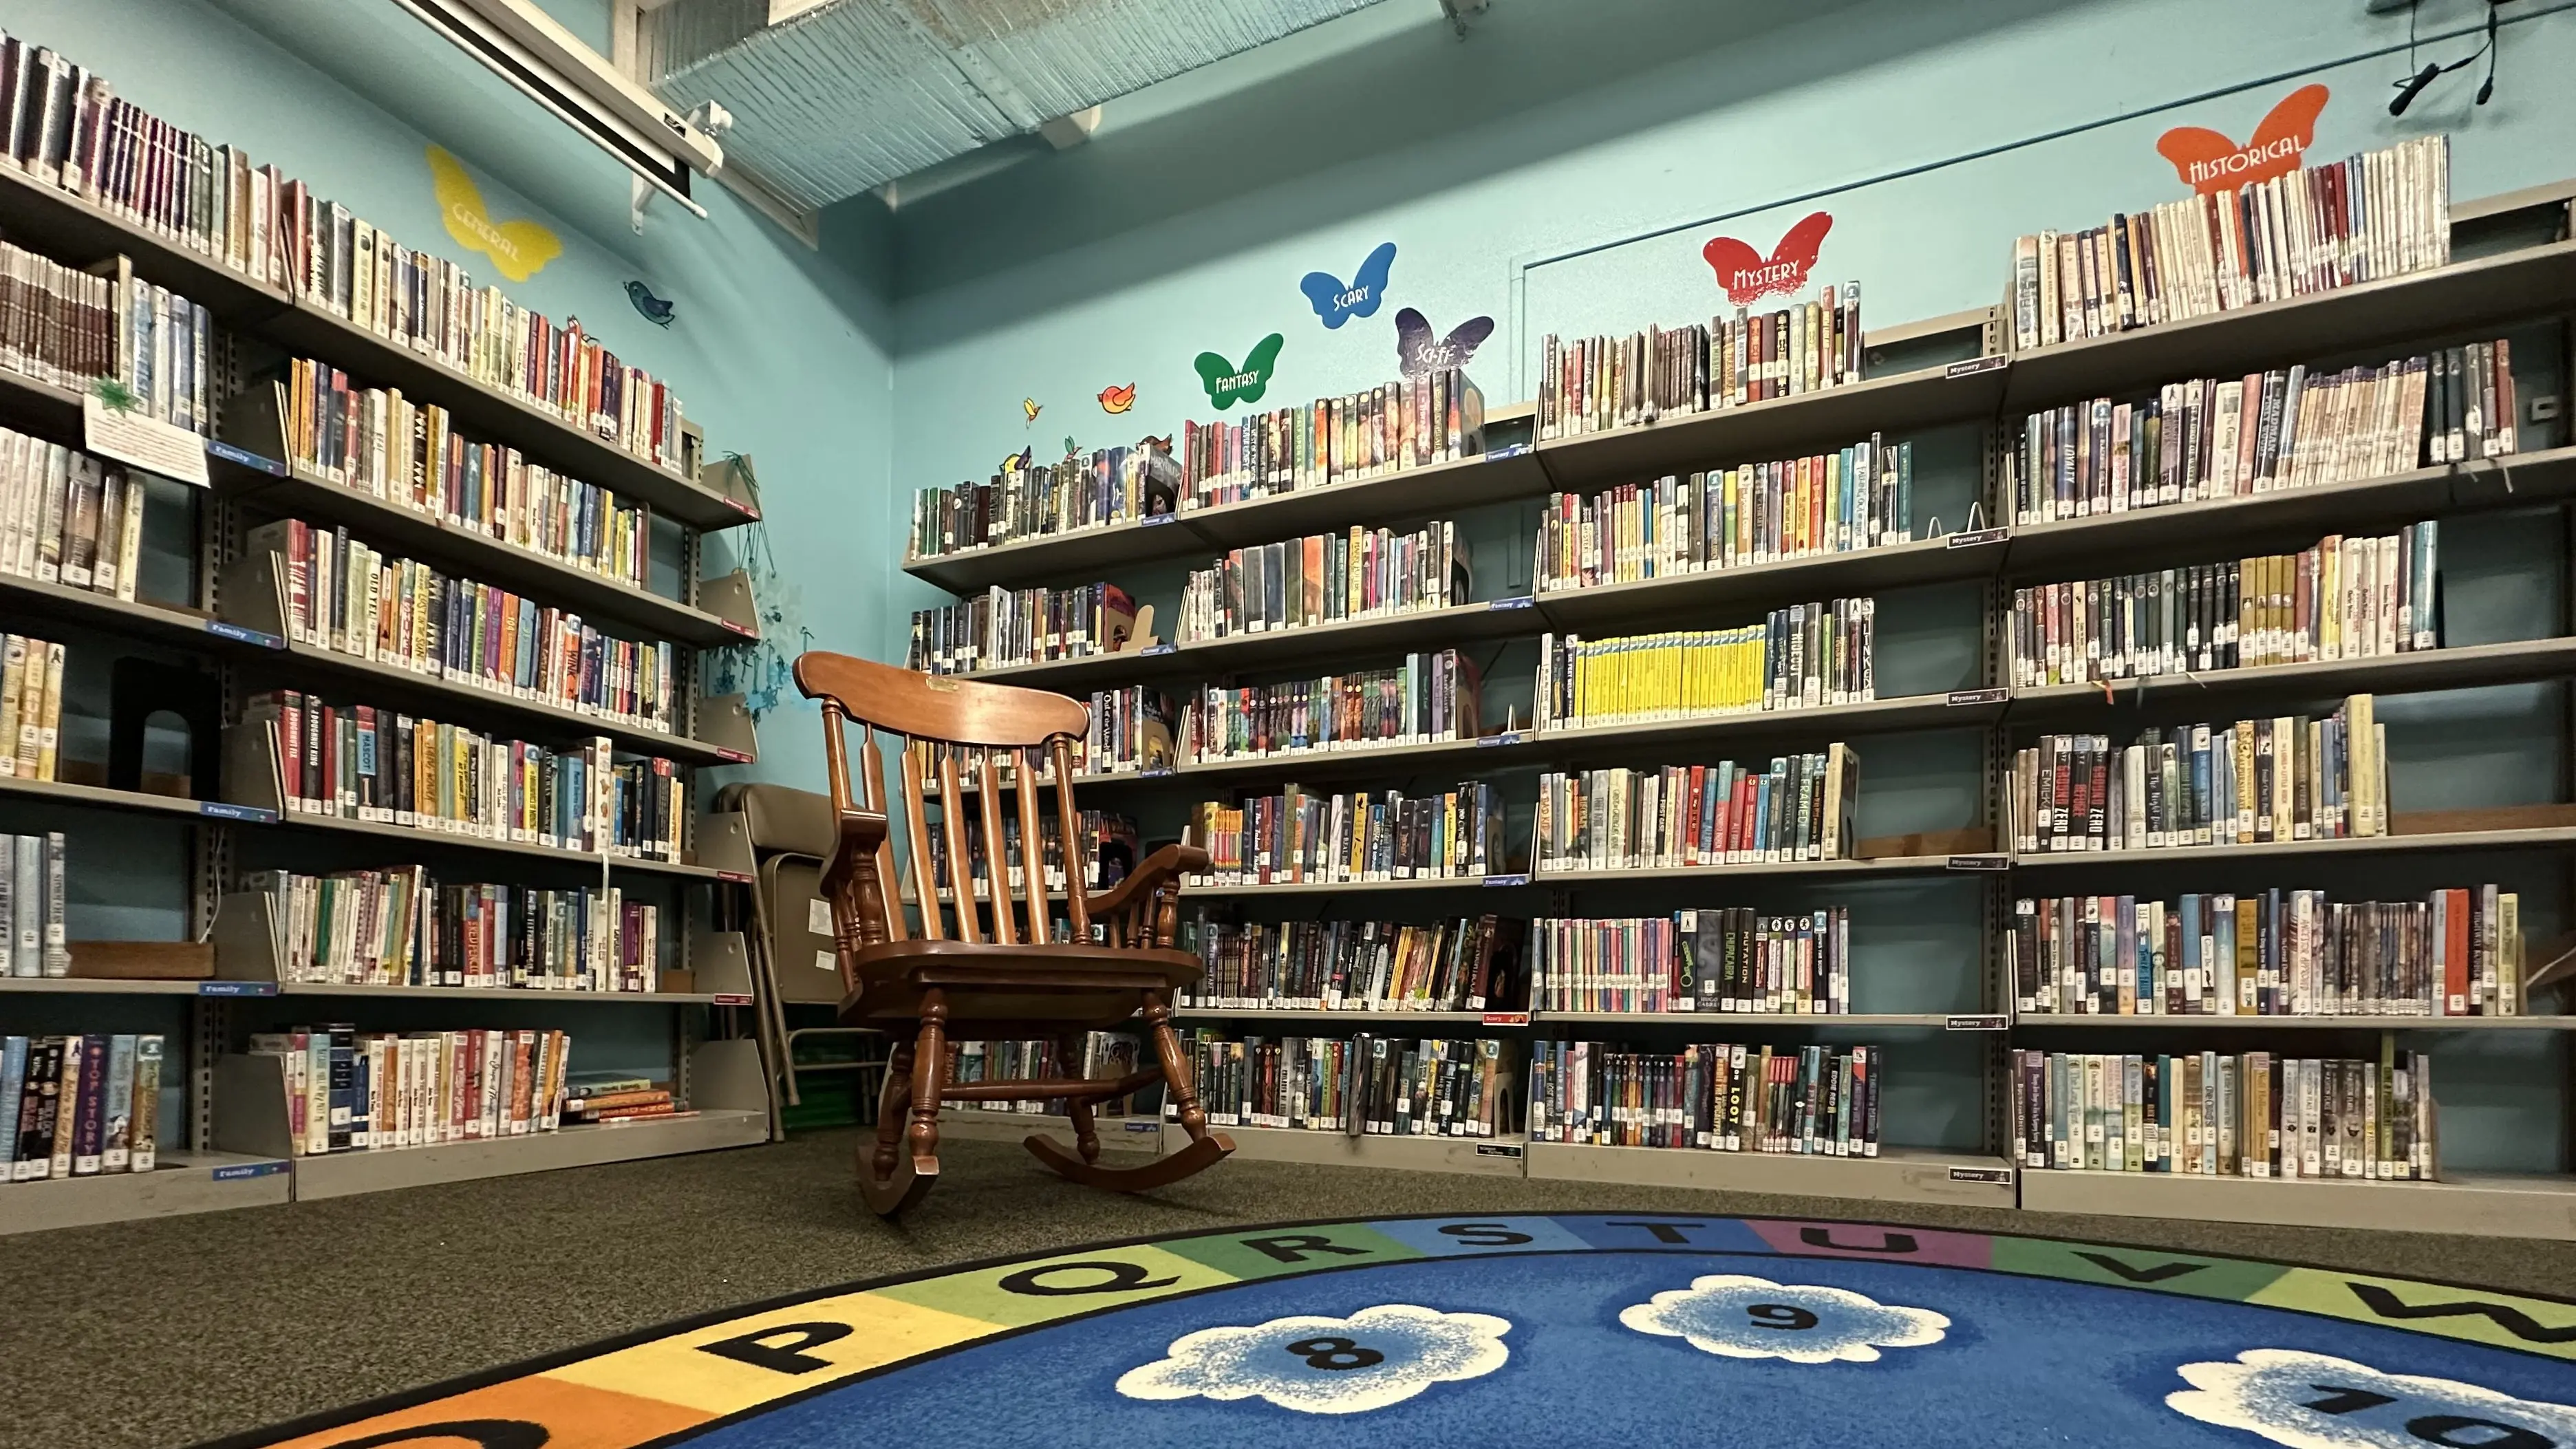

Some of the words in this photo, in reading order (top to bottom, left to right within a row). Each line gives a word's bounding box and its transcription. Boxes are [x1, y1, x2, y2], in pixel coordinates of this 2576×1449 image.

[2189, 135, 2305, 183] HISTORICAL
[451, 204, 521, 263] GENERAL
[1733, 259, 1800, 290] MYSTERY
[1333, 285, 1369, 312] SCARY
[1216, 370, 1259, 394] FANTASY
[1951, 363, 1980, 374] Mystery
[2268, 399, 2281, 452] MADMAN
[215, 446, 249, 462] Family
[2064, 444, 2074, 484] LOYALTY
[1951, 535, 1982, 544] Mystery
[213, 624, 247, 638] Family
[568, 649, 580, 677] WINK
[1791, 634, 1802, 677] HIDEOUT
[1103, 694, 1113, 709] Out
[1951, 694, 1981, 702] Mystery
[361, 734, 371, 770] MASCOT
[2056, 765, 2070, 804] GROUND
[2092, 765, 2106, 804] GROUND
[2150, 776, 2160, 788] The
[208, 806, 242, 817] Family
[2073, 784, 2086, 817] REFUGEE
[2149, 792, 2160, 814] Night
[2054, 808, 2068, 833] ZERO
[2089, 808, 2104, 833] ZERO
[2203, 938, 2213, 954] Glory
[2300, 919, 2310, 954] ANCESTOR
[1725, 932, 1735, 980] CHUPACABRA
[1730, 1086, 1740, 1124] LOOT
[219, 1168, 255, 1177] Family
[696, 1322, 853, 1375] P
[1000, 1262, 1181, 1296] Q
[1239, 1236, 1373, 1263] R
[1437, 1224, 1534, 1246] S
[1605, 1222, 1706, 1244] T
[1800, 1228, 1919, 1254] U
[2071, 1252, 2211, 1283] V
[2346, 1282, 2576, 1344] W
[1747, 1305, 1818, 1331] 9
[1285, 1337, 1384, 1371] 8
[2301, 1384, 2557, 1449] 10
